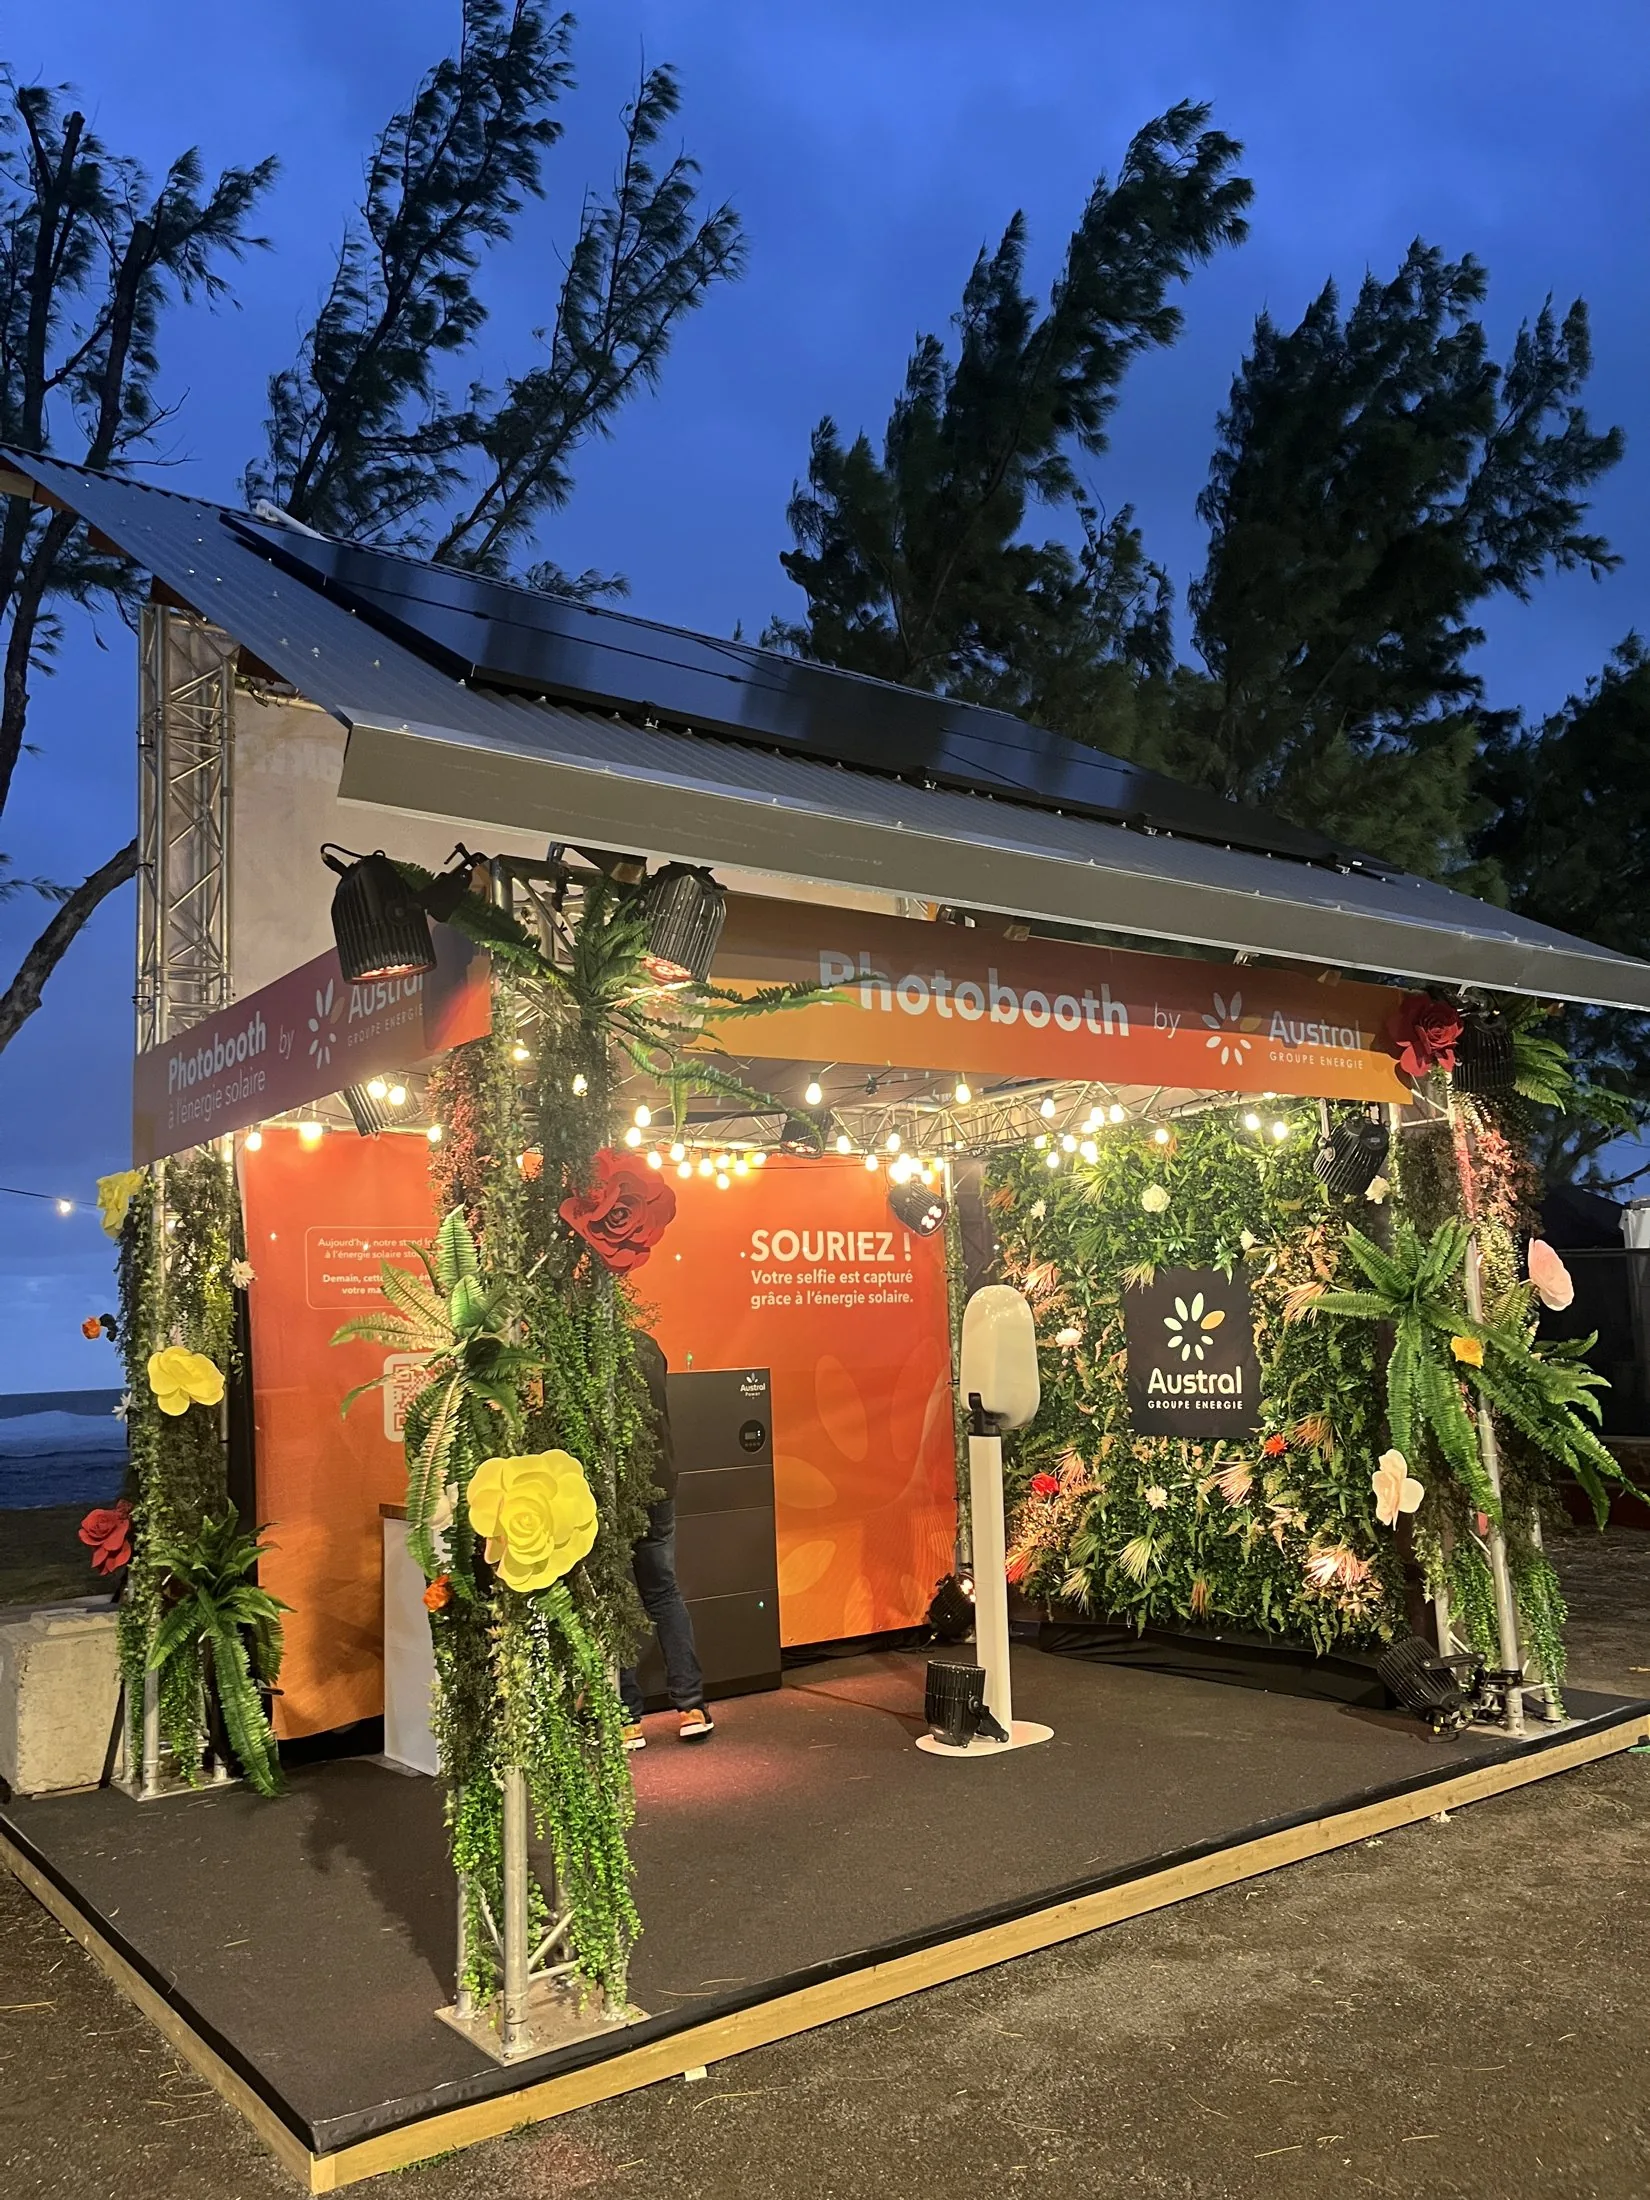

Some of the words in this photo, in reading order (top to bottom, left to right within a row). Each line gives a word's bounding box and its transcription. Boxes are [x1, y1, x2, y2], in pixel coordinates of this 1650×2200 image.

[818, 949, 1129, 1037] Photobooth
[1154, 1001, 1181, 1039] by
[348, 1021, 380, 1047] GROUPE
[385, 1003, 423, 1031] ENERGIE
[1269, 1010, 1361, 1050] Austral
[168, 1010, 266, 1095] Photobooth
[279, 1024, 295, 1060] by
[1269, 1051, 1315, 1064] GROUPE
[1320, 1055, 1364, 1069] ENERGIE
[225, 1067, 265, 1105] solaire
[373, 1239, 397, 1247] notre
[750, 1229, 895, 1262] SOURIEZ
[903, 1232, 912, 1262] !
[324, 1250, 331, 1259] à
[333, 1250, 371, 1260] l'énergie
[372, 1250, 401, 1258] solaire
[322, 1273, 361, 1283] Demain,
[751, 1270, 793, 1284] Votre
[796, 1268, 836, 1284] selfie
[839, 1271, 860, 1283] est
[863, 1269, 913, 1287] capturé
[751, 1291, 791, 1309] grâce
[795, 1290, 803, 1305] à
[807, 1289, 865, 1308] l'énergie
[868, 1289, 913, 1304] solaire.
[740, 1382, 766, 1392] Austral
[1147, 1366, 1243, 1395] Austral
[1147, 1400, 1190, 1410] GROUPE
[1195, 1400, 1243, 1410] ENERGIE
